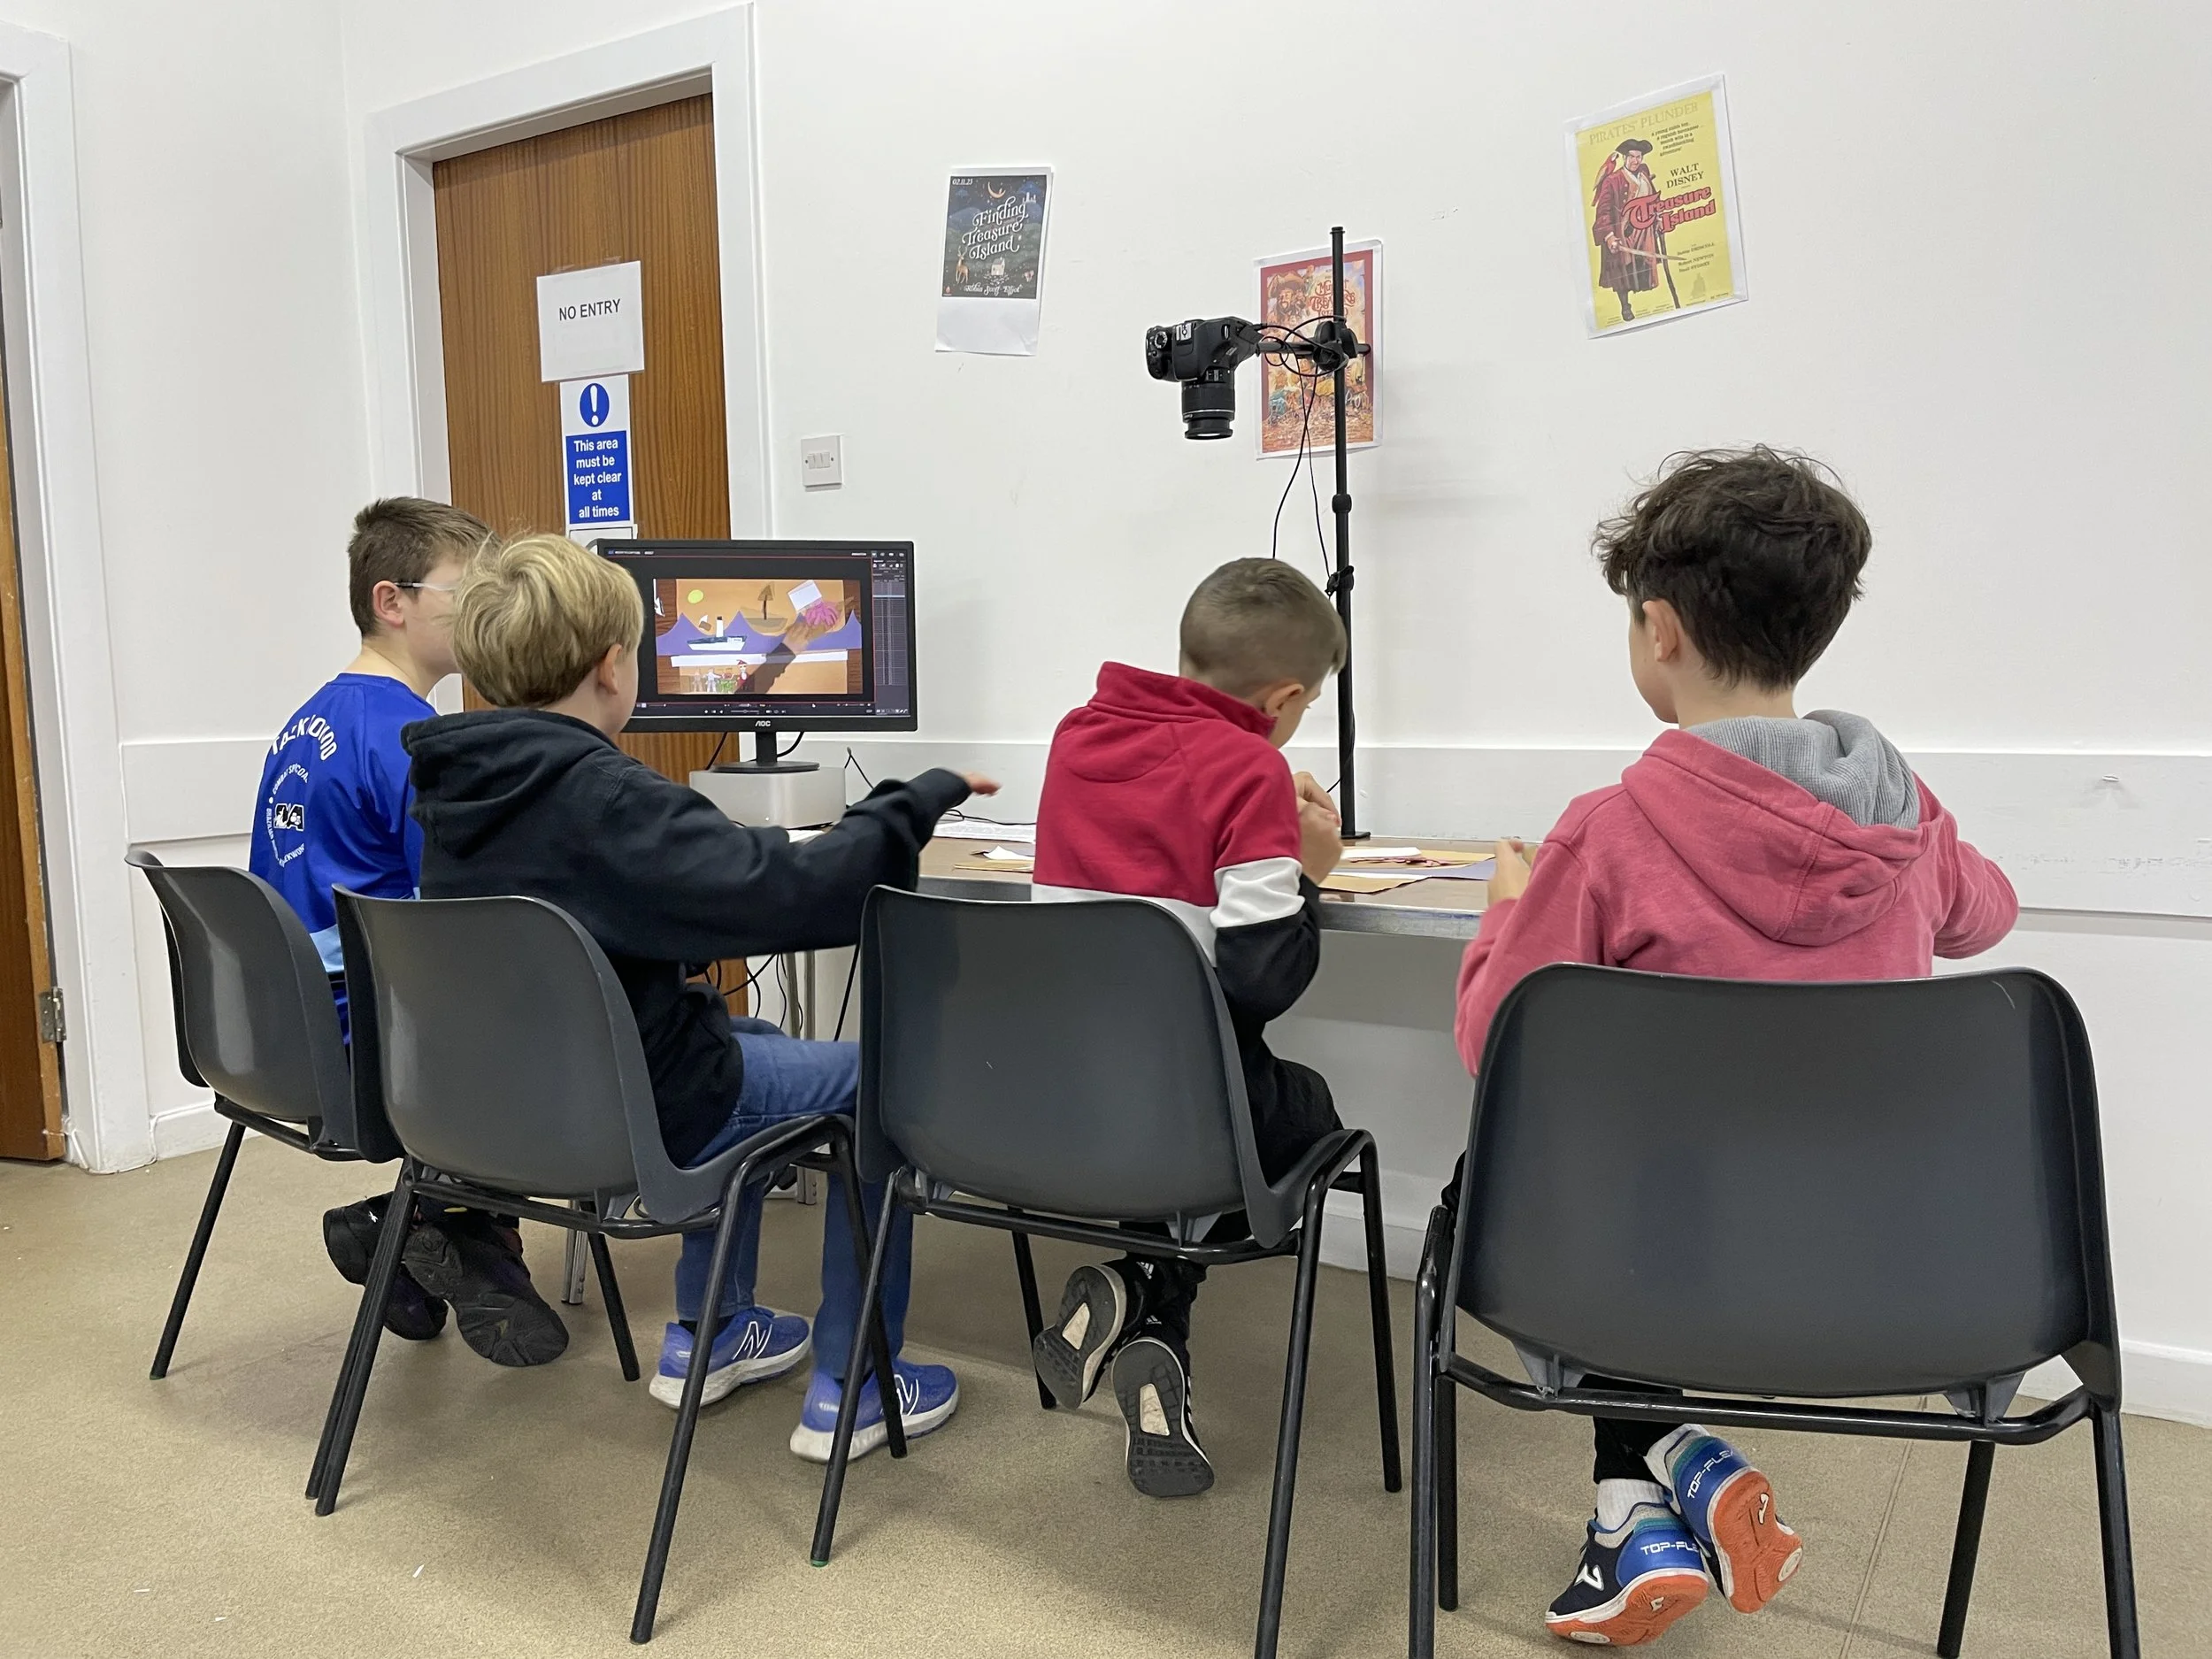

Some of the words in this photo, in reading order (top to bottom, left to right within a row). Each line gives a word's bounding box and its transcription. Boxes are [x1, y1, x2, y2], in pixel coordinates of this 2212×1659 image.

[1640, 102, 1698, 128] PLUNDER
[1666, 171, 1704, 188] DISNEY
[1670, 163, 1699, 177] WALT
[972, 196, 1029, 227] Finding
[1621, 187, 1712, 229] Treasure
[1660, 198, 1717, 234] Island
[962, 221, 1023, 246] Treasure
[969, 234, 1020, 260] Island
[558, 306, 577, 321] NO
[580, 298, 621, 319] ENTRY
[573, 439, 595, 452] This
[596, 439, 618, 450] area
[576, 455, 601, 469] must
[602, 454, 615, 466] be
[573, 472, 595, 488] kept
[597, 471, 622, 484] clear
[591, 488, 602, 501] at
[579, 505, 590, 518] all
[592, 505, 619, 518] times
